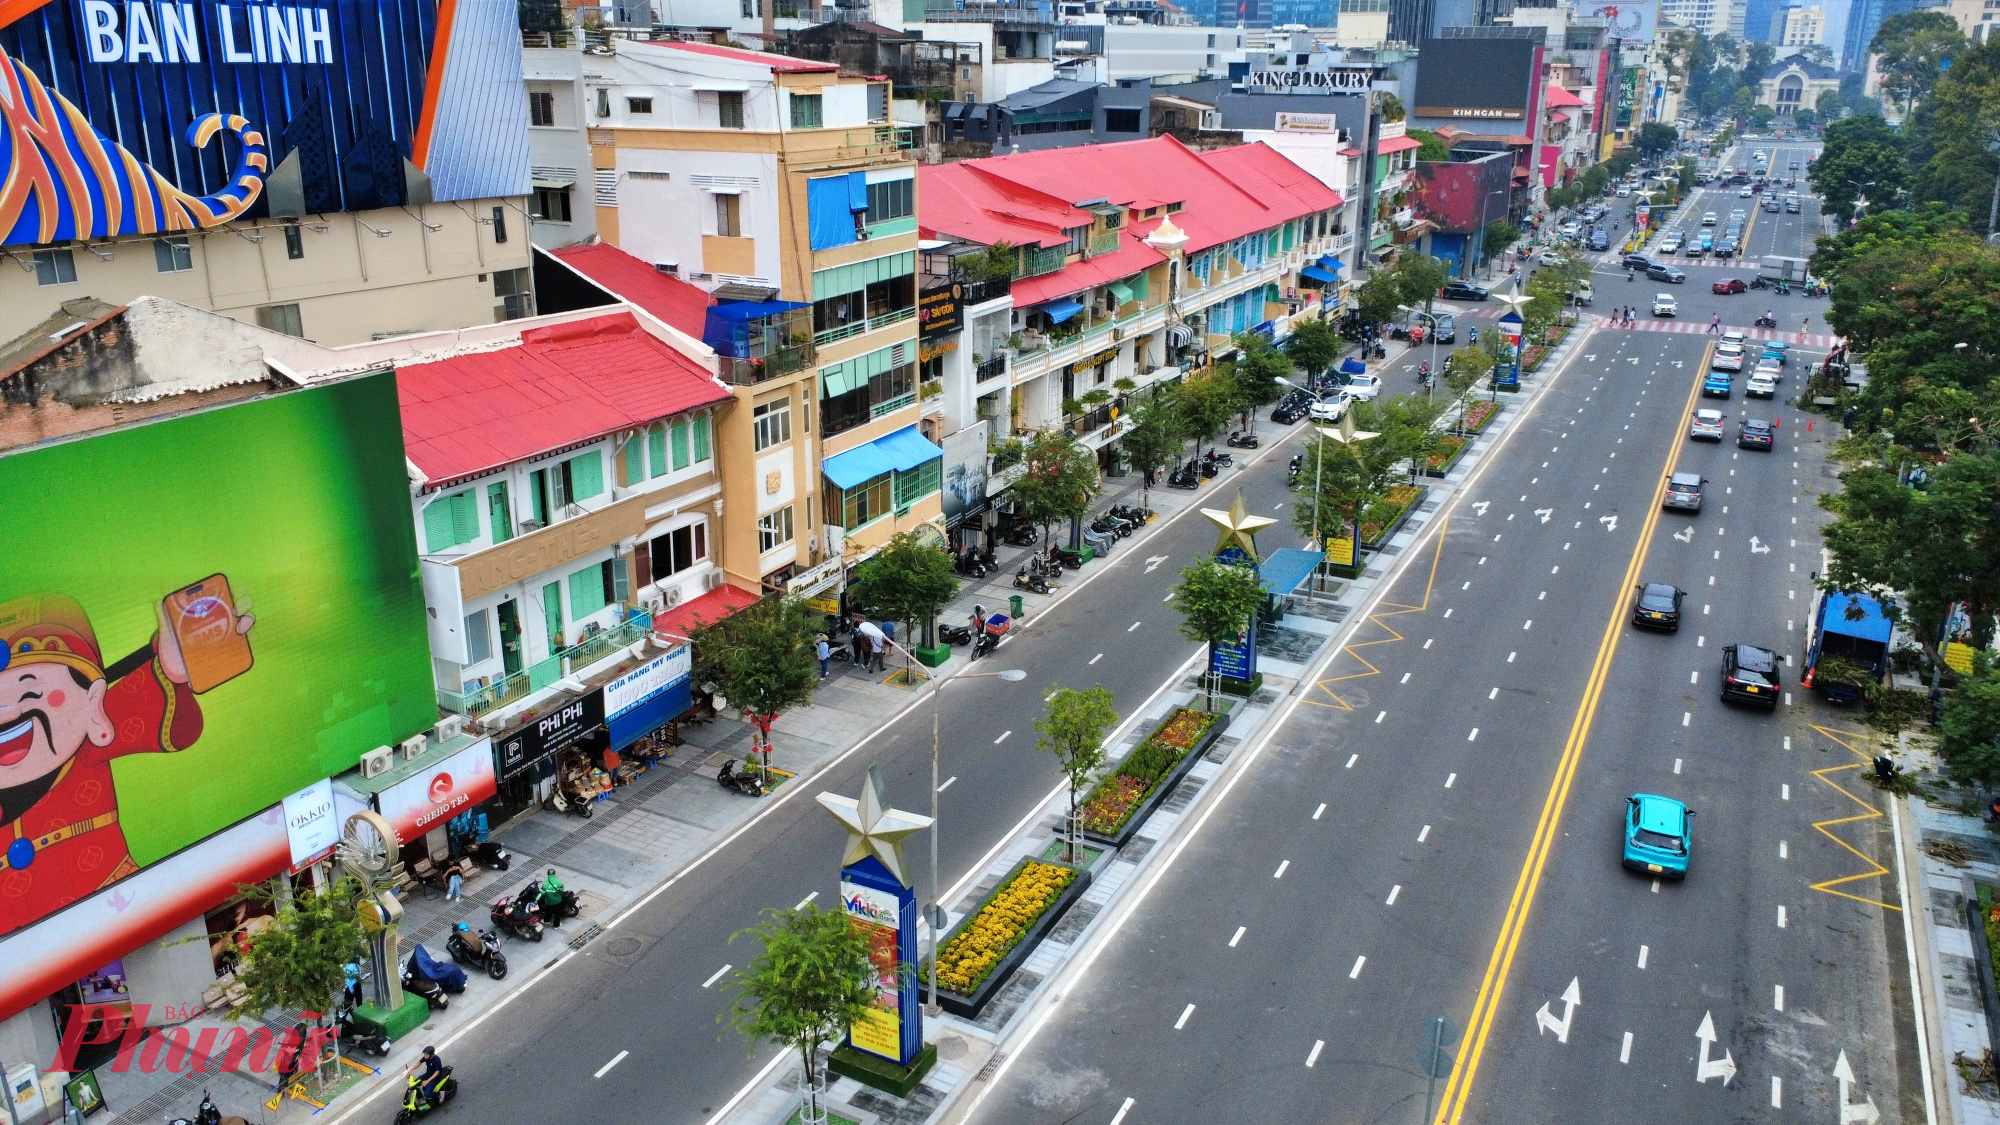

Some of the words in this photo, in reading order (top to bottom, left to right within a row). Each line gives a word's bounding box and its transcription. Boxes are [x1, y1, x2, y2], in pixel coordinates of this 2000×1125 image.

[1250, 71, 1293, 87] KING
[1298, 71, 1373, 88] LUXURY
[1473, 109, 1502, 117] NGAN
[608, 678, 626, 693] CỬA
[627, 664, 650, 682] HÀNG
[666, 645, 687, 662] NGHỆ
[612, 678, 649, 710] NGỌC
[450, 793, 470, 809] TEA
[291, 801, 331, 828] OKKIO
